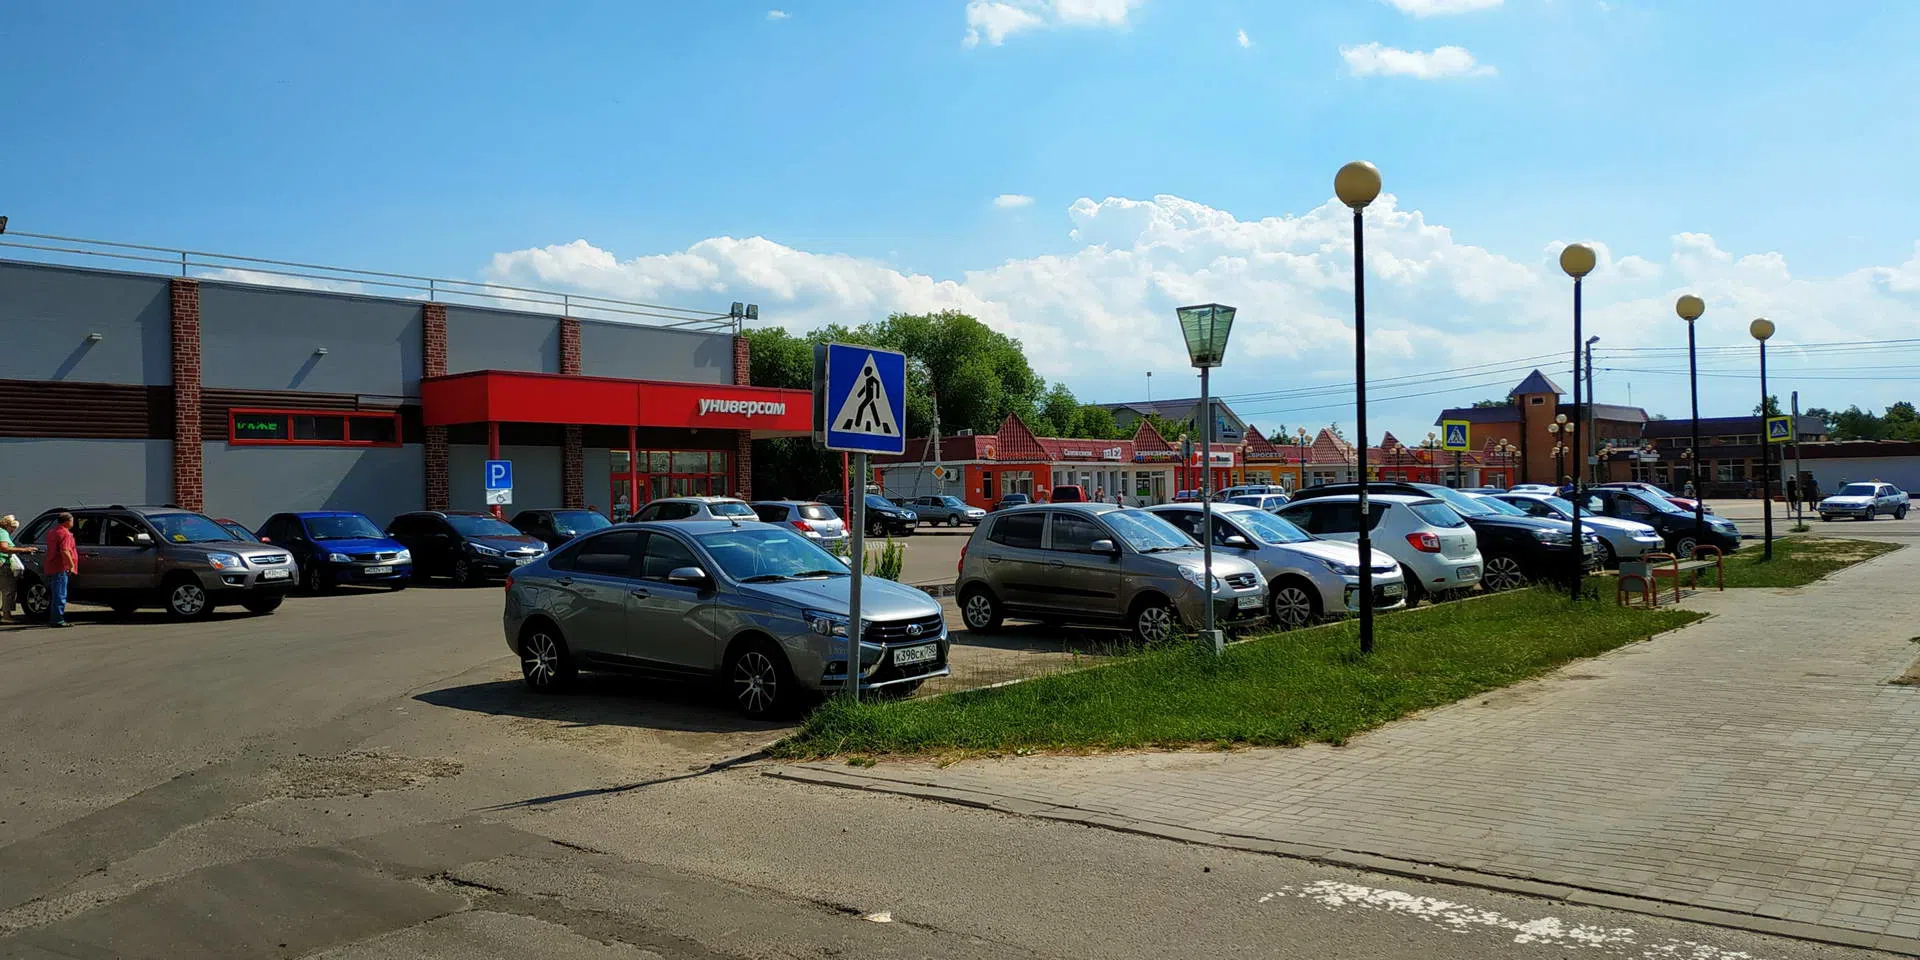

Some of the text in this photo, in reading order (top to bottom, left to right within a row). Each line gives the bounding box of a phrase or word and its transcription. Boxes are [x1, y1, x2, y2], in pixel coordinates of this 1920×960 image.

[699, 398, 785, 418] универсам
[491, 464, 505, 487] P
[895, 648, 924, 662] К398СК
